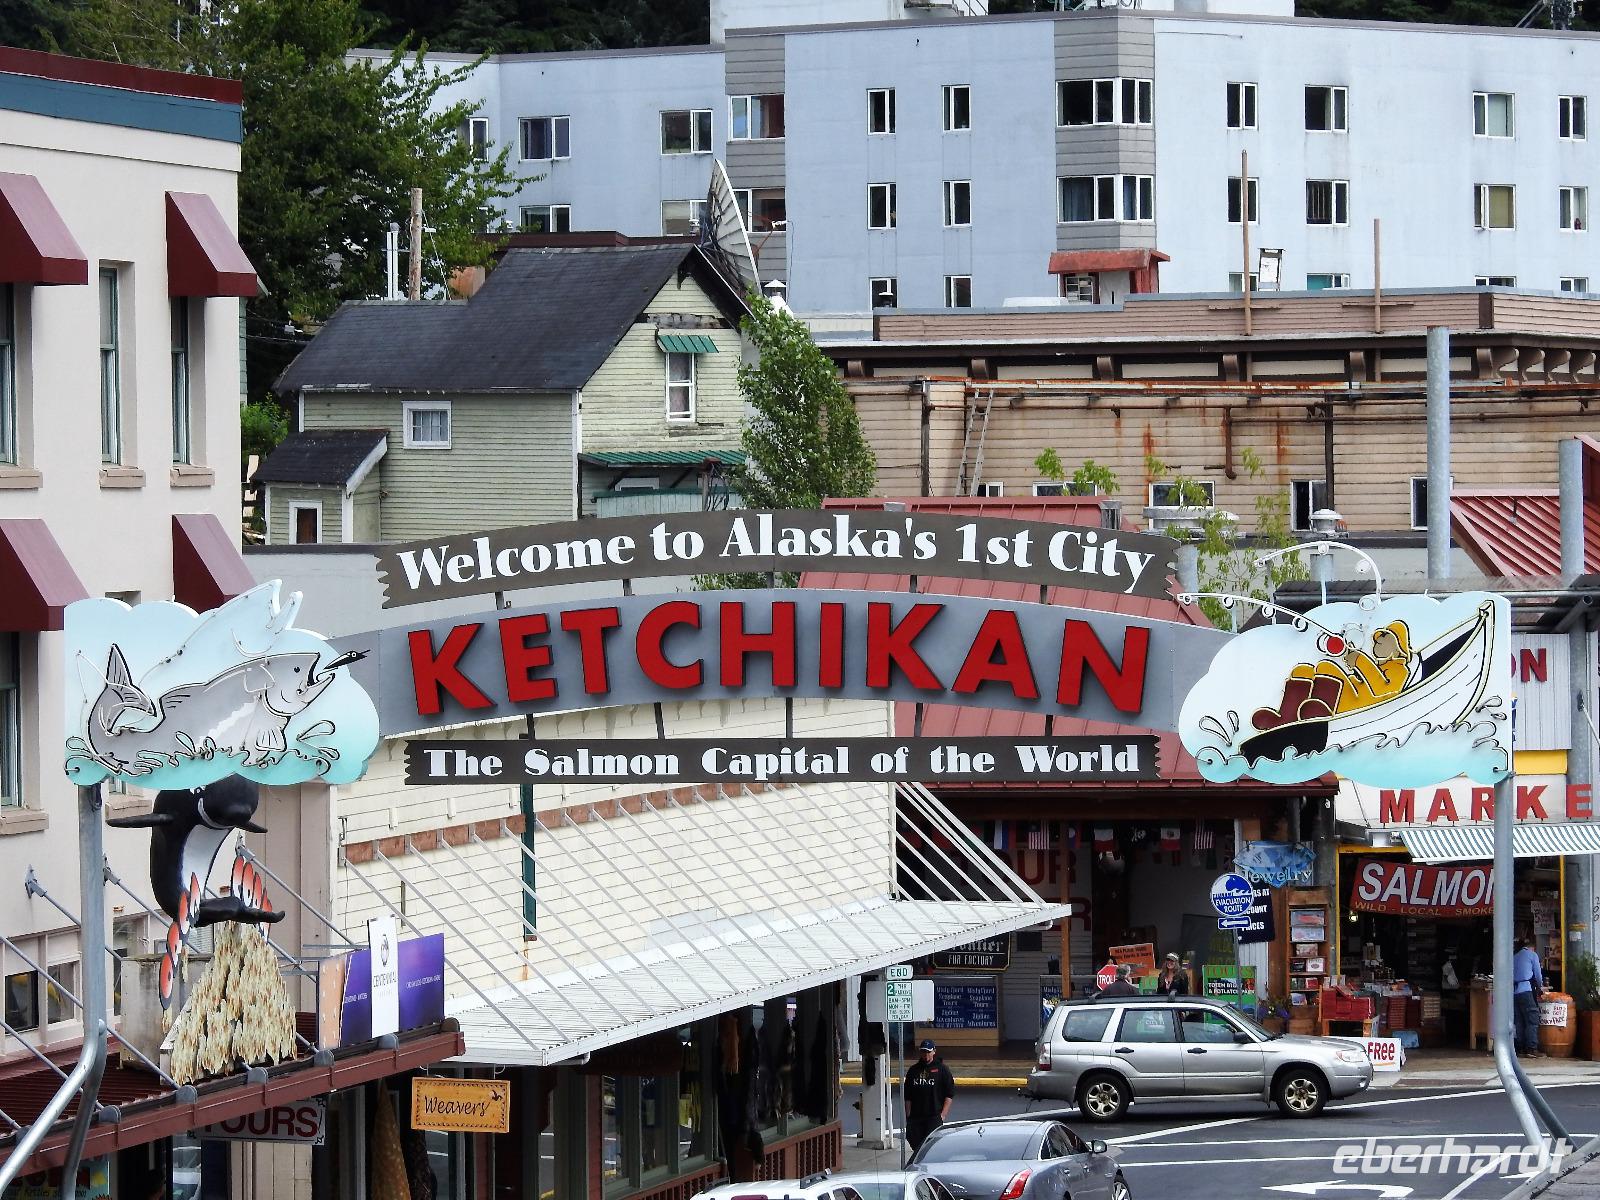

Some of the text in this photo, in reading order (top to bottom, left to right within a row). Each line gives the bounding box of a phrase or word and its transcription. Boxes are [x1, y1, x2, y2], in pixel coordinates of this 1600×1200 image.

[396, 514, 1154, 593] Welcome to Alaska's 1st City
[407, 600, 1151, 715] KETCHIKAN
[424, 745, 1140, 781] The Salmon Capital of the World
[1242, 867, 1312, 883] Jewelry
[1262, 888, 1270, 897] AT
[1215, 896, 1251, 906] EVACUATION
[1244, 905, 1268, 915] COUNT
[1355, 901, 1387, 912] WILD
[1400, 906, 1441, 916] LOCAL
[948, 955, 994, 966] FUR FACTORY
[891, 968, 908, 977] END
[1206, 966, 1253, 978] TOUS
[887, 984, 894, 995] 2
[913, 1078, 935, 1086] KING
[424, 1095, 490, 1117] Weavers
[205, 1106, 318, 1138] OURS
